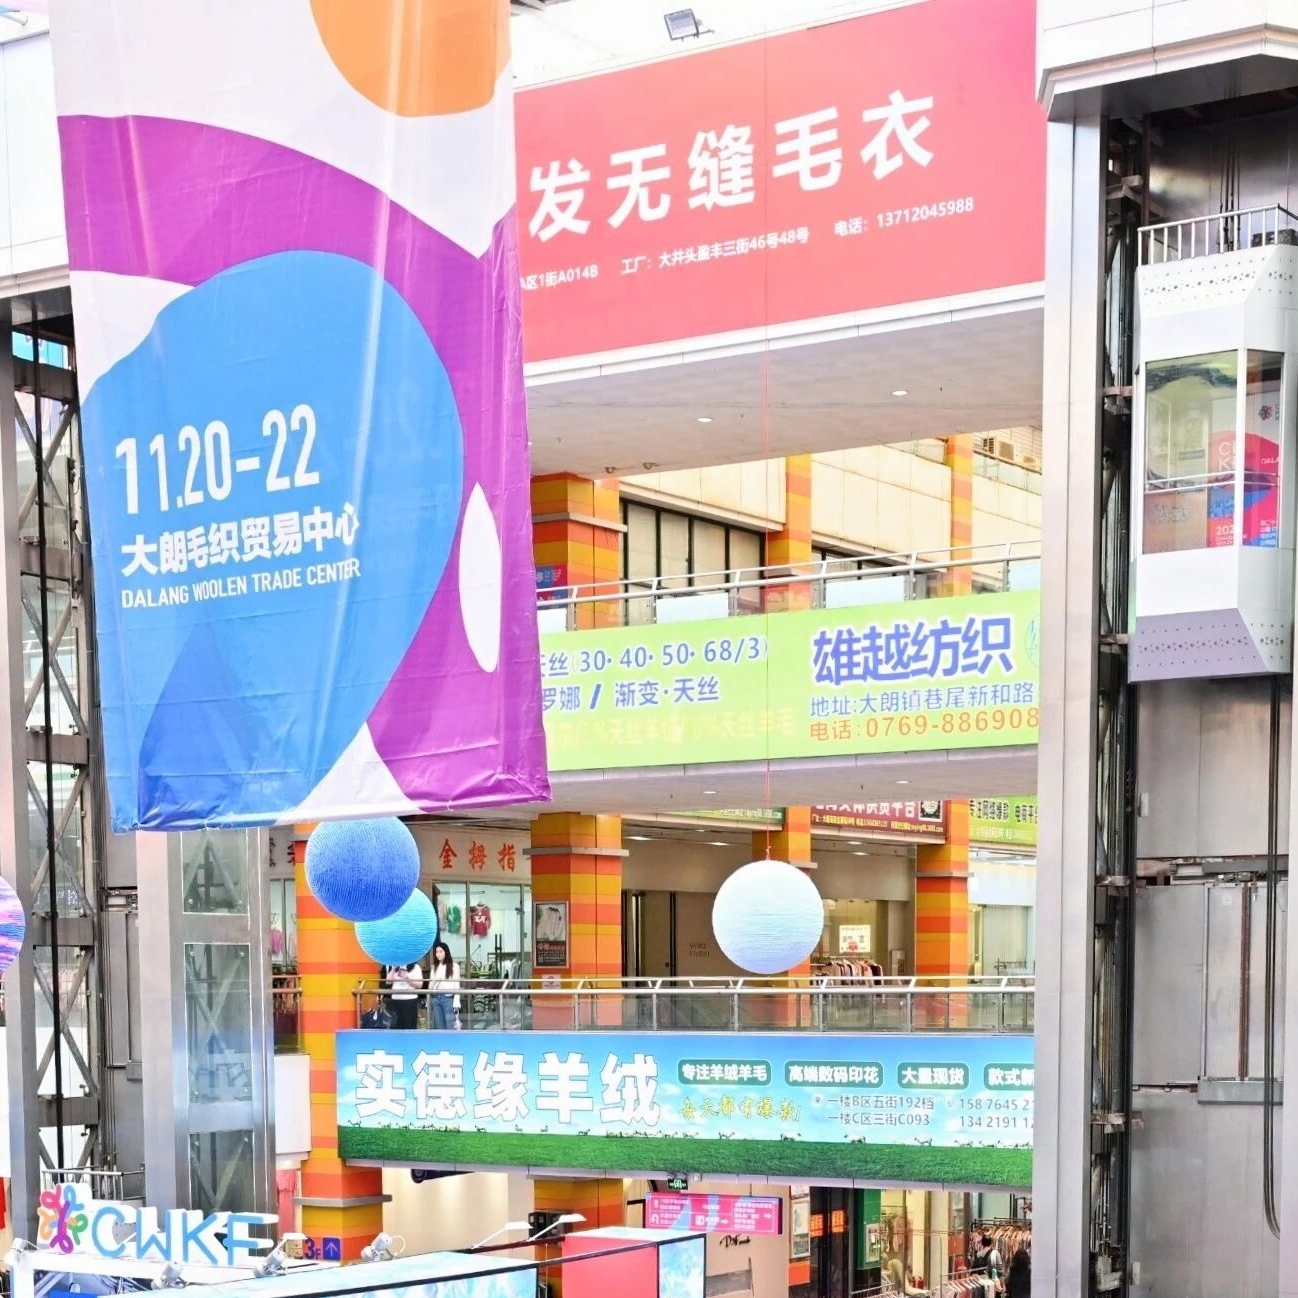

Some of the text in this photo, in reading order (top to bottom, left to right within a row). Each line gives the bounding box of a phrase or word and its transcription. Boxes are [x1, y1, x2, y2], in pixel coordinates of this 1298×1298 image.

[528, 90, 935, 242] 发无缝毛衣
[876, 196, 975, 229] 13712045988
[121, 502, 360, 580] 大朗毛织贸易中心
[121, 557, 362, 609] DALANG WOOLEN TRADE CENTER
[811, 617, 1014, 688] 雄越纺织
[355, 1049, 663, 1129] 实德缘羊绒
[901, 1067, 966, 1086] 大量现货
